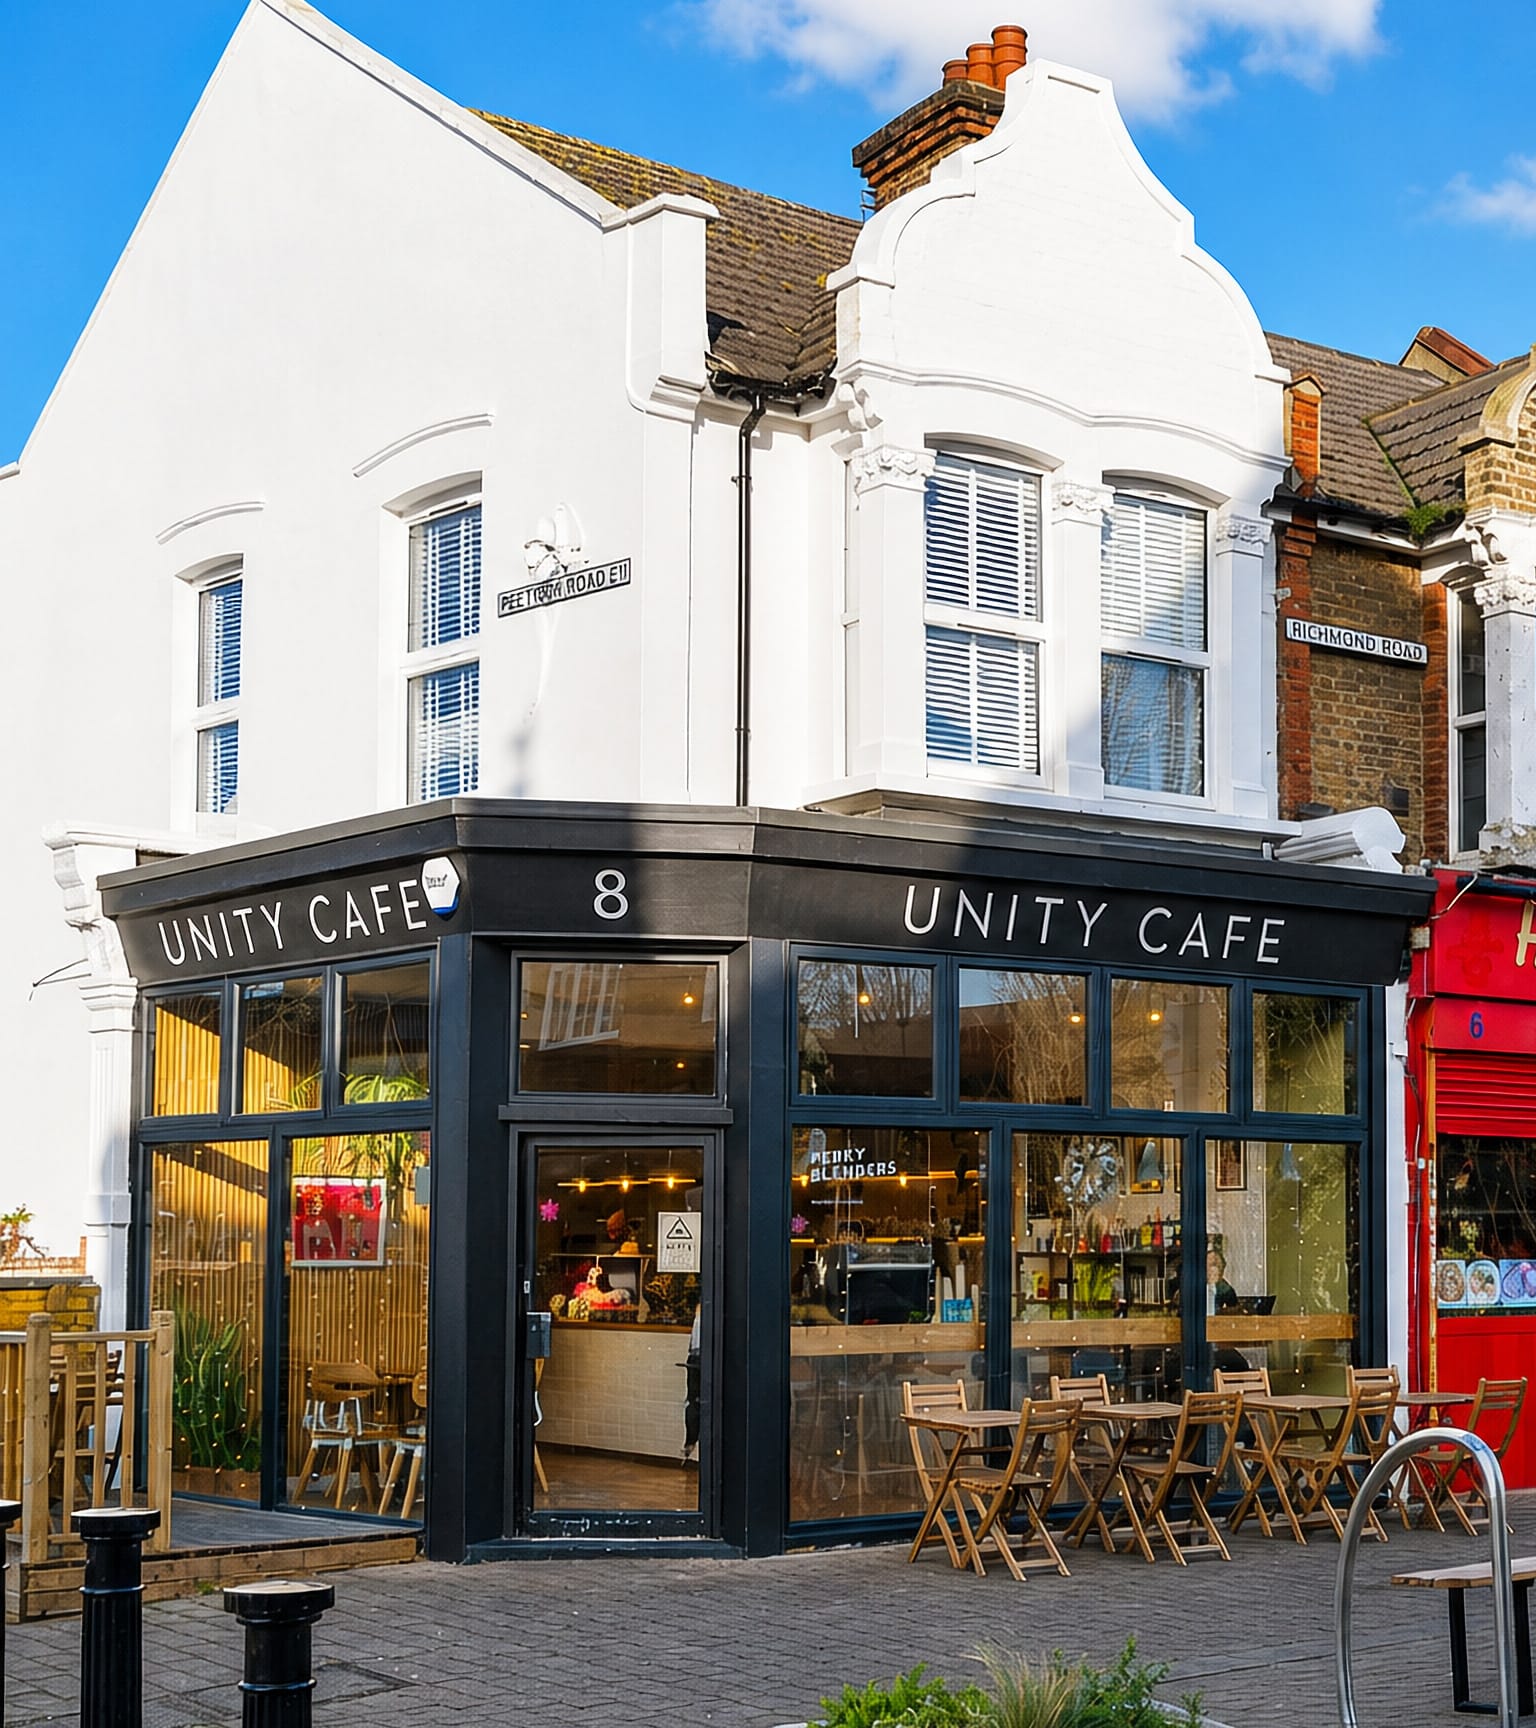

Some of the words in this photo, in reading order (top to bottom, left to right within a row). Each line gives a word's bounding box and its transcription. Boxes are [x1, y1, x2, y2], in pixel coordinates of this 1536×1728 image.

[566, 570, 605, 595] ROAD
[1292, 621, 1377, 652] RICHMOND
[1382, 639, 1423, 660] ROAD
[593, 868, 629, 920] 8
[157, 901, 282, 966] UNITY
[308, 879, 428, 944] CAFE
[903, 884, 1108, 947] UNITY
[1137, 906, 1286, 964] CAFE
[1469, 1011, 1484, 1039] 6
